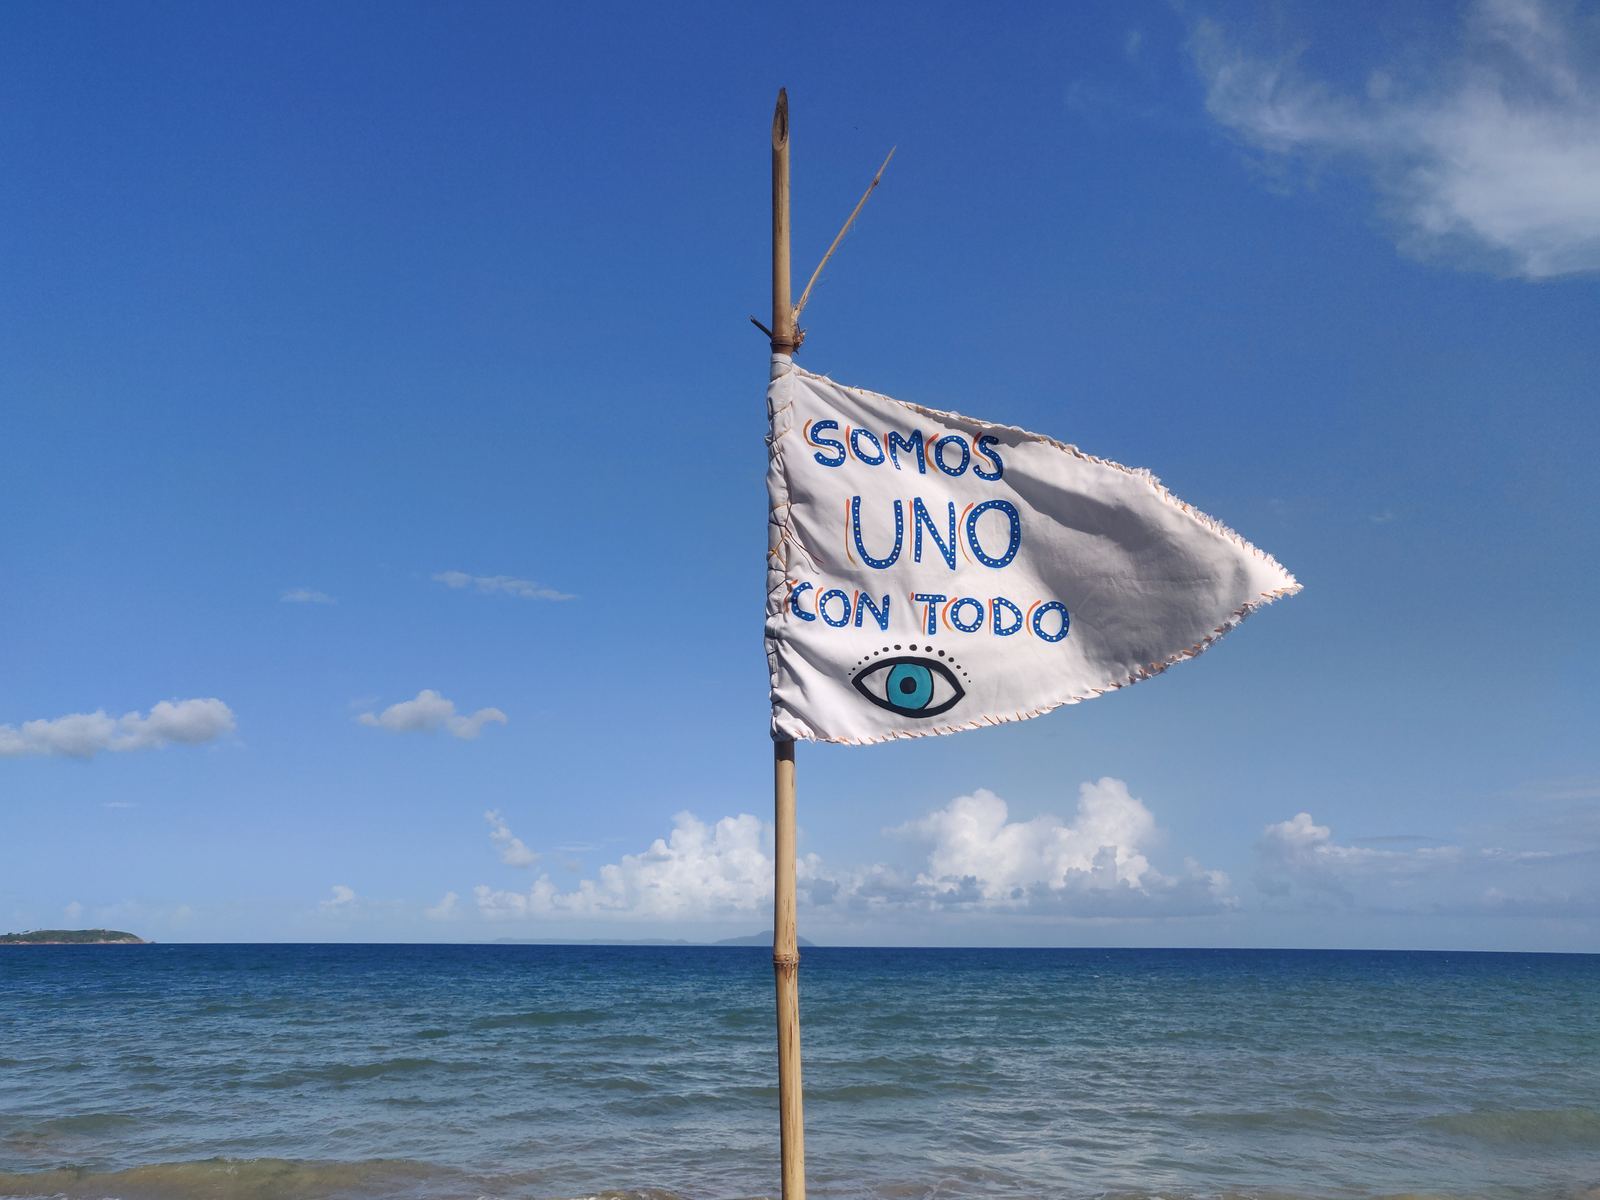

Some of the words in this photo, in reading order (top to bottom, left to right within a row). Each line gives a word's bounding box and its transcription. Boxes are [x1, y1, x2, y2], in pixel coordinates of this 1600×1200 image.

[809, 420, 1004, 481] SOMOS
[851, 495, 1021, 571] UNO
[790, 582, 891, 632] CON
[914, 593, 1071, 644] TODO
